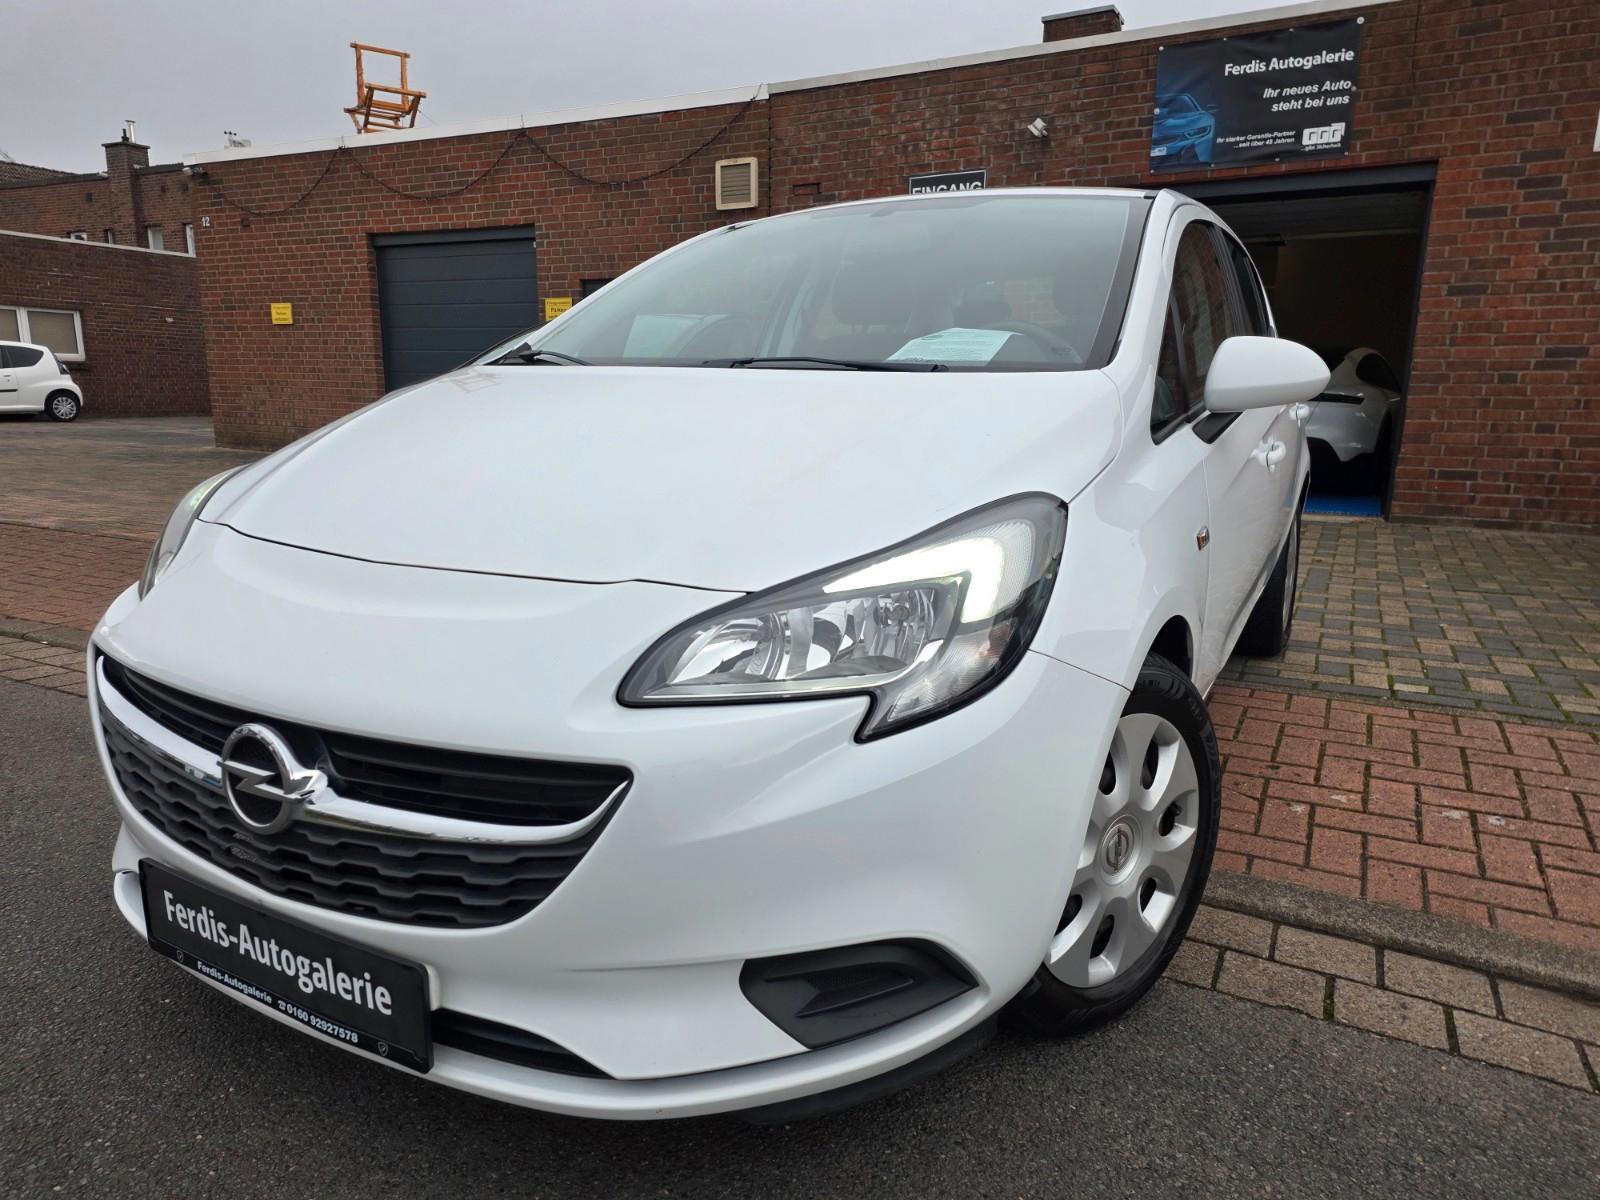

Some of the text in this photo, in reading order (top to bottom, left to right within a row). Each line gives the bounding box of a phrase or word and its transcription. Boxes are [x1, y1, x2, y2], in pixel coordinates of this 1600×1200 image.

[1224, 48, 1355, 76] Ferdis Autogalerie
[1263, 79, 1352, 99] Ihr neues Auto
[1271, 95, 1350, 112] steht bei uns
[201, 216, 211, 227] 12
[163, 890, 392, 1016] Ferdis-Autogalerie
[197, 960, 273, 1004] Ferdis-Autogalerie
[310, 1015, 359, 1044] 92927578
